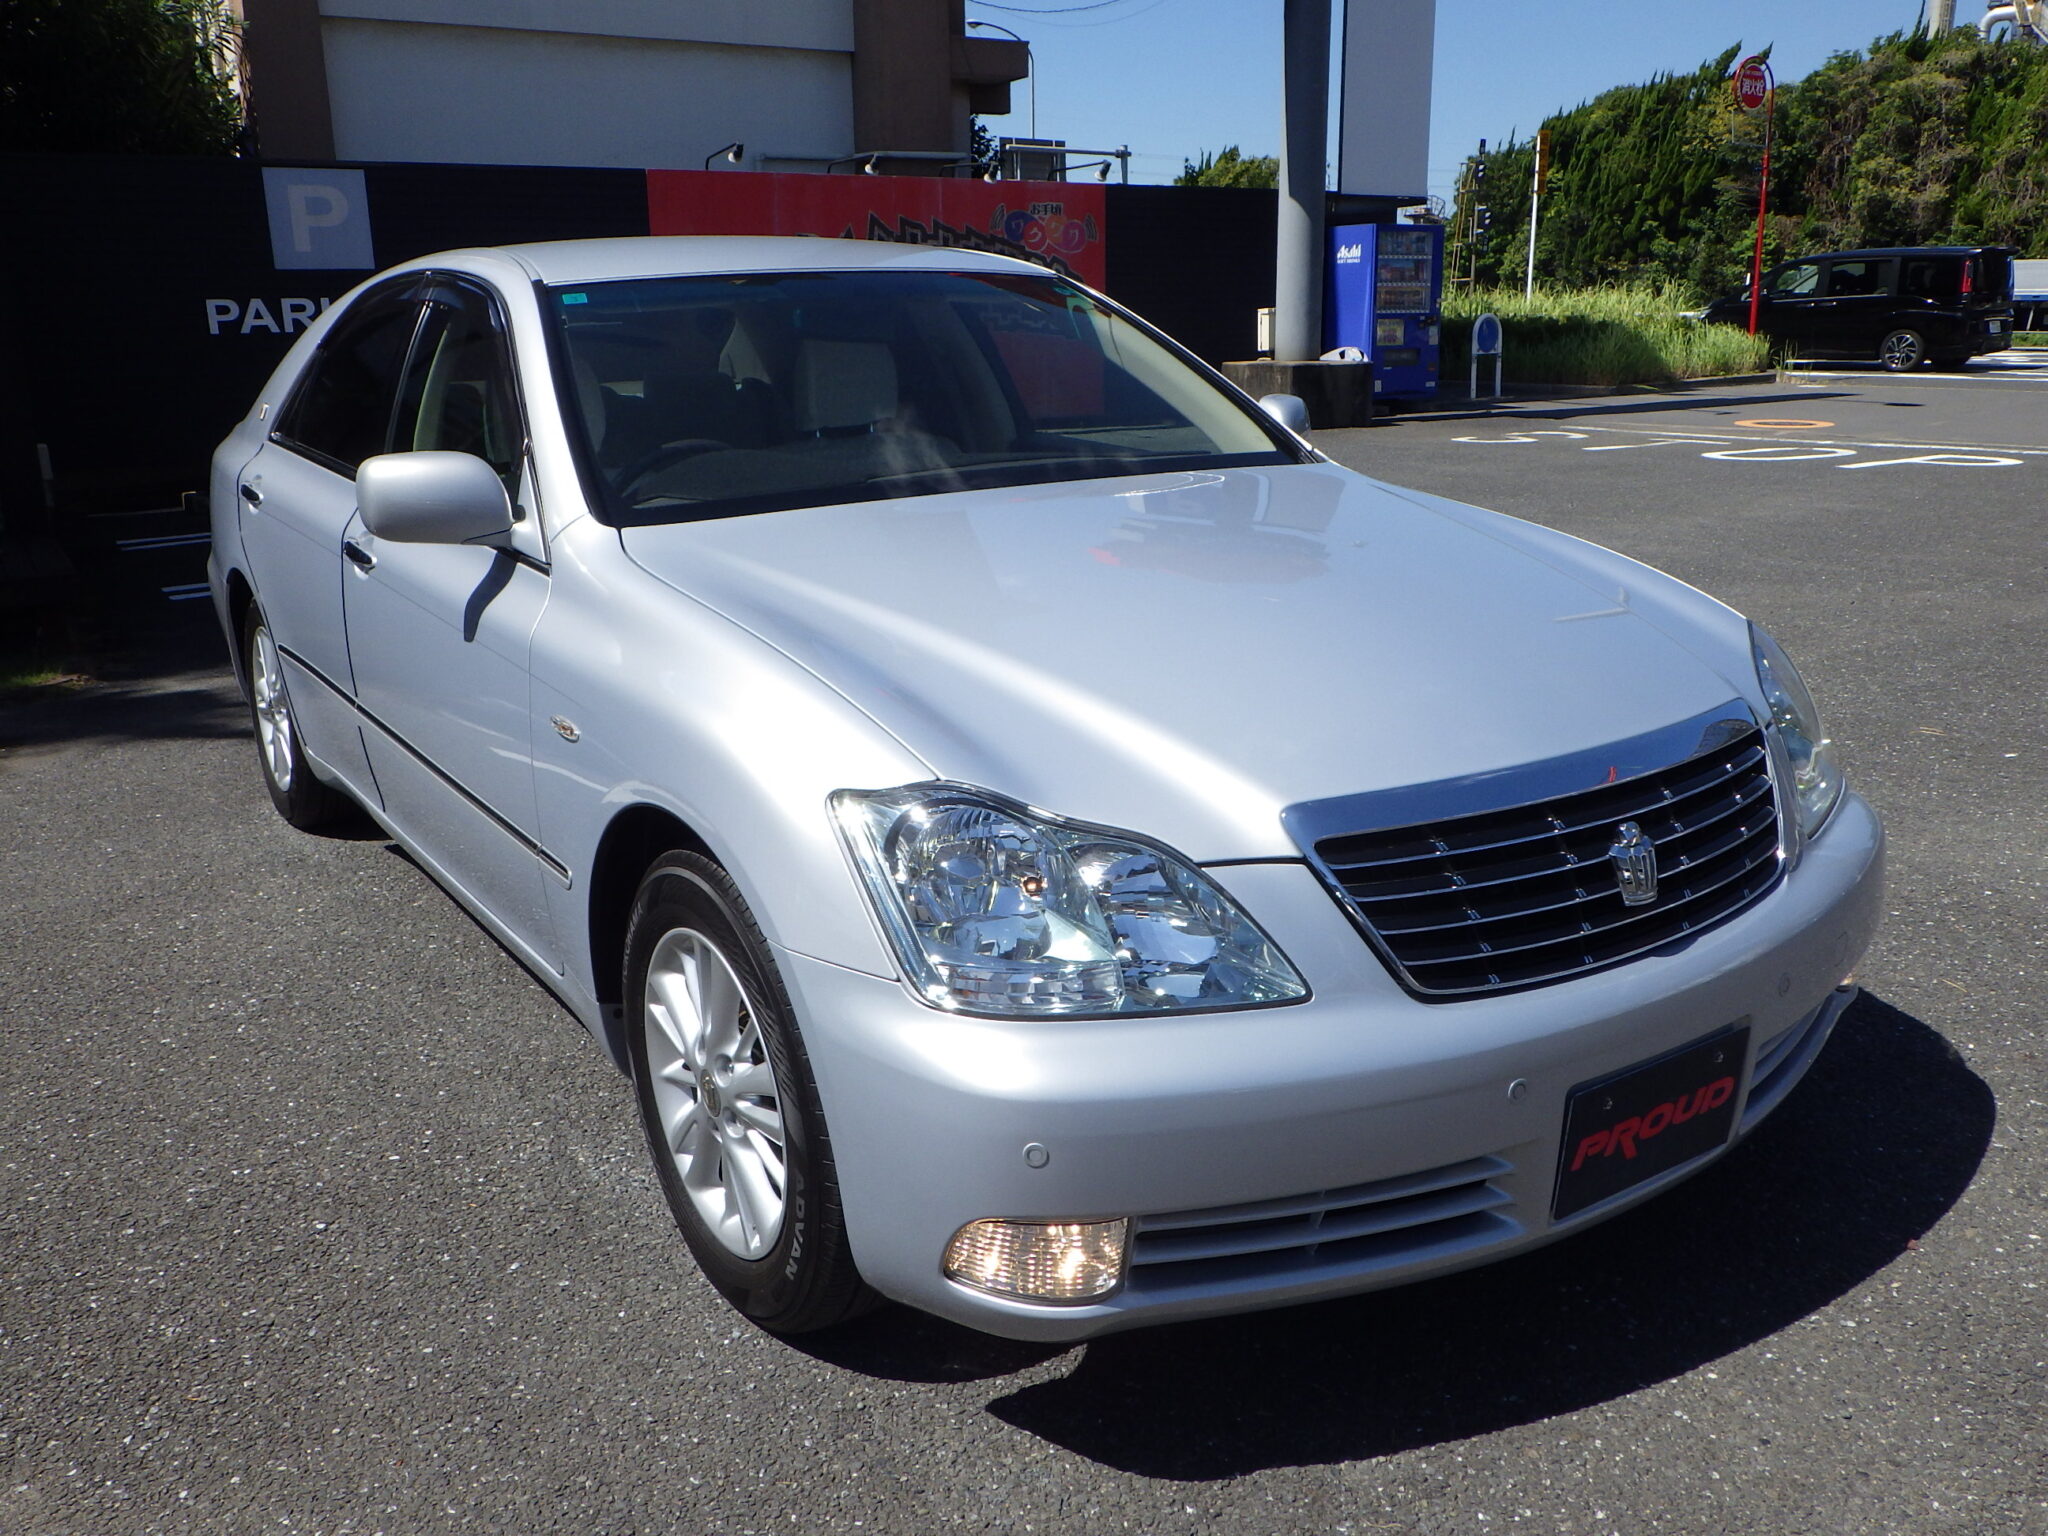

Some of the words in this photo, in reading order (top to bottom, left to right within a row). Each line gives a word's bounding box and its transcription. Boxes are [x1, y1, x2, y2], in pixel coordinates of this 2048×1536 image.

[286, 184, 349, 253] P
[205, 297, 331, 335] PAR
[1451, 431, 2025, 470] STOP
[1569, 1076, 1736, 1173] PROUD
[785, 1168, 806, 1281] ADVAN
